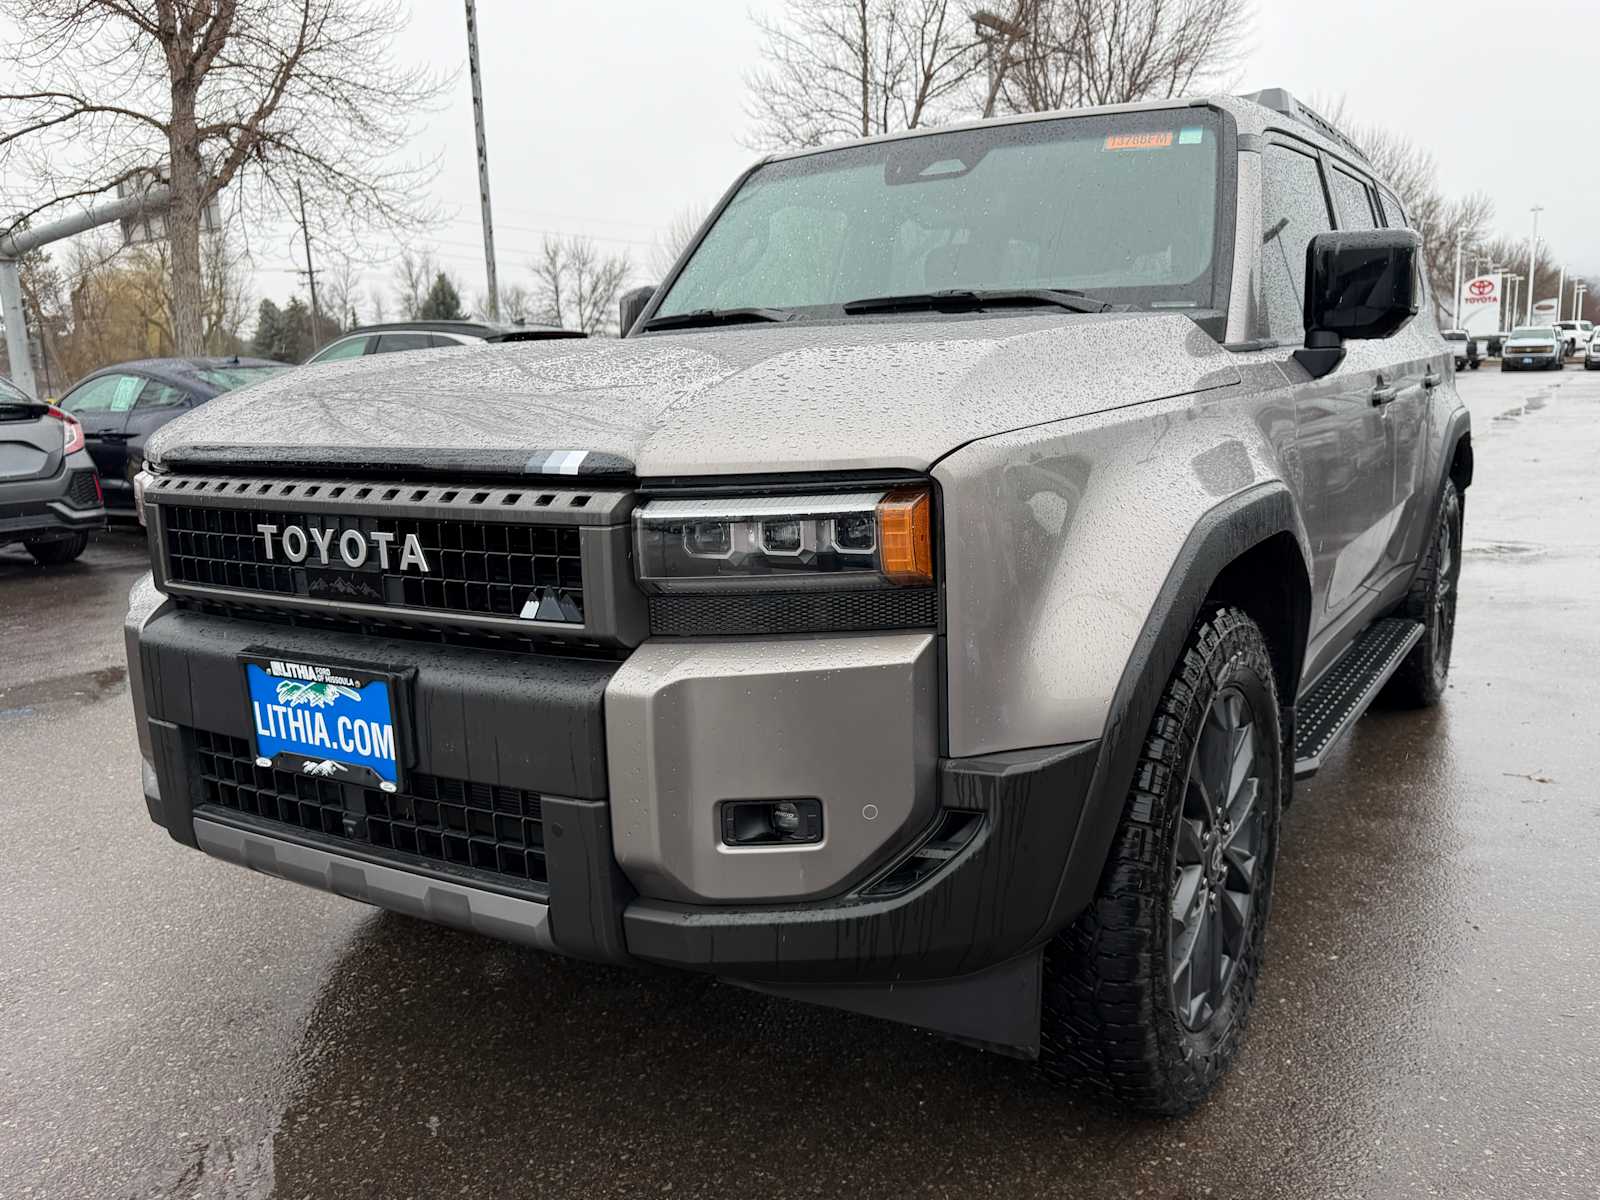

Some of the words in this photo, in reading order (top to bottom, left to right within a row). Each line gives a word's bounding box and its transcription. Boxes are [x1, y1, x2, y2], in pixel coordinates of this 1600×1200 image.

[1465, 296, 1498, 304] TOYOTA
[257, 524, 430, 573] TOYOTA
[281, 662, 317, 681] LITHIA
[325, 676, 355, 687] MISSOULA
[253, 701, 396, 761] LITHIA.COM
